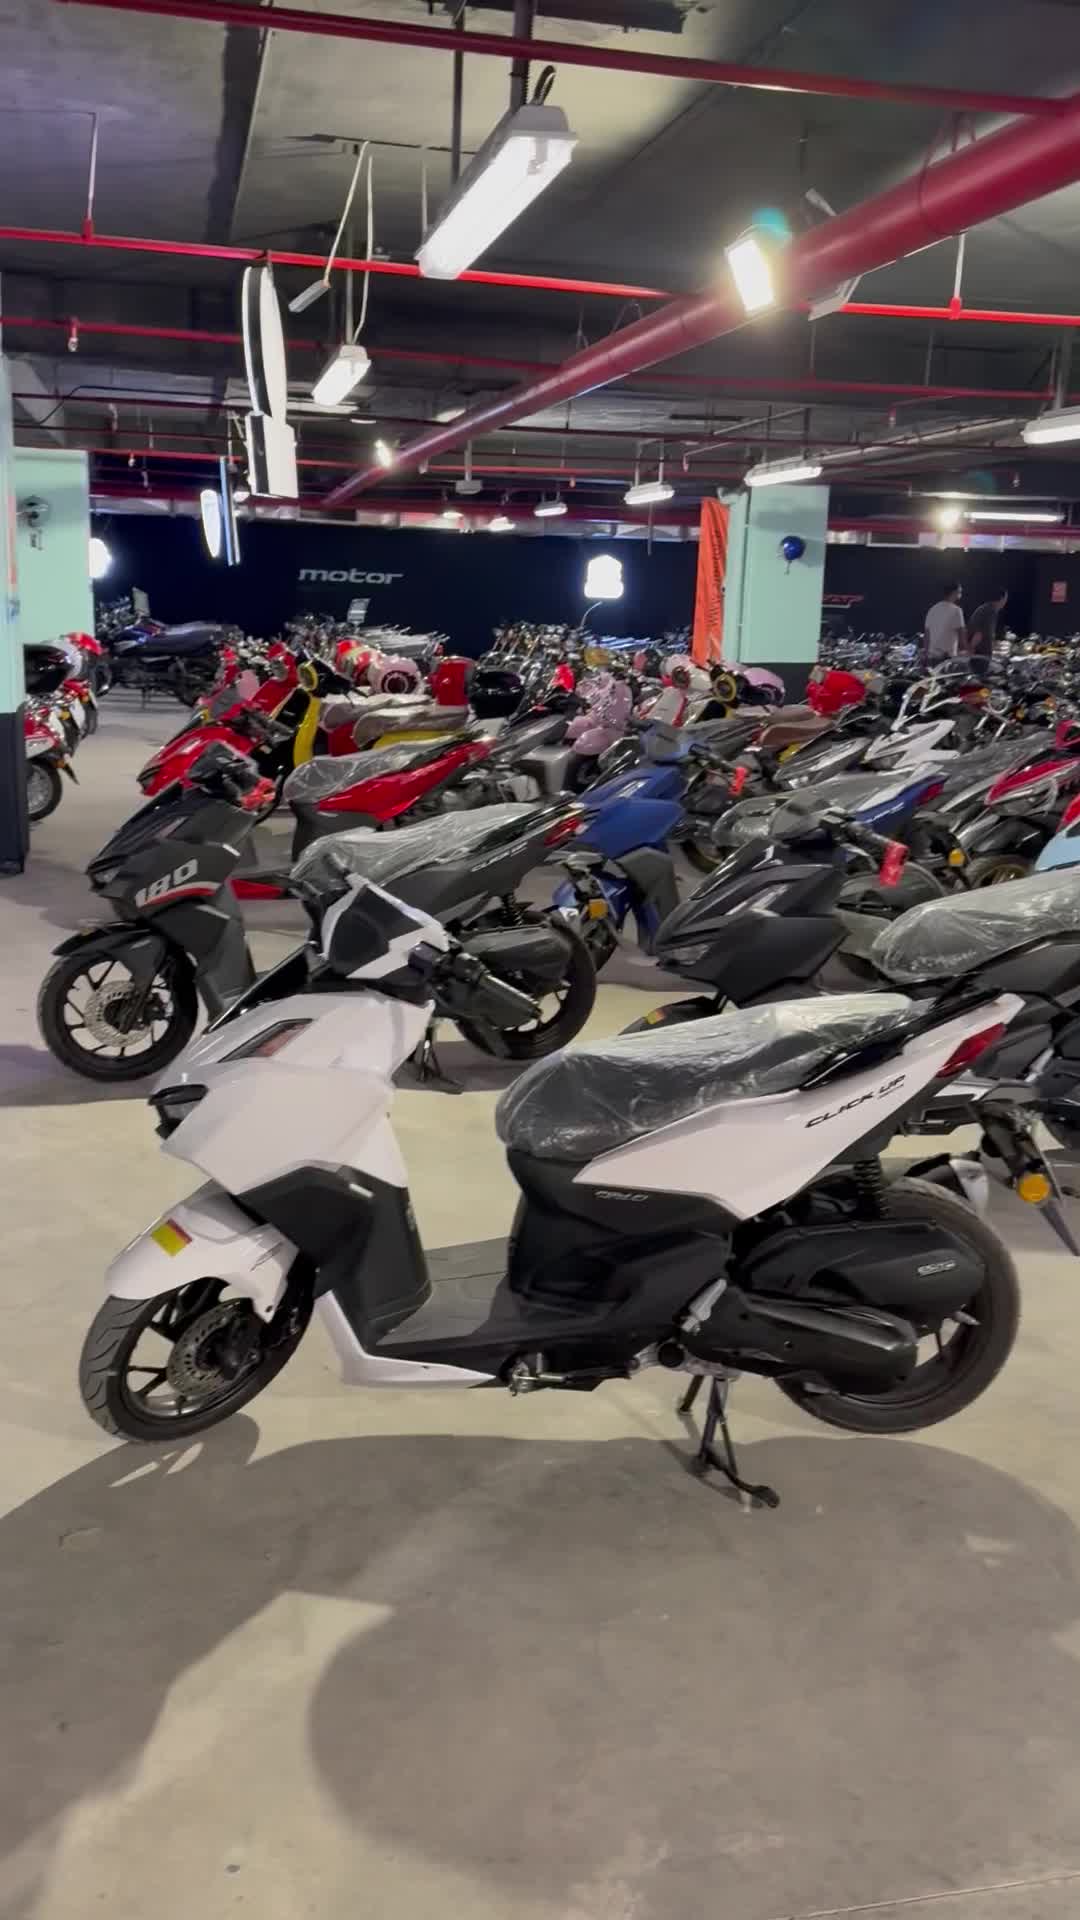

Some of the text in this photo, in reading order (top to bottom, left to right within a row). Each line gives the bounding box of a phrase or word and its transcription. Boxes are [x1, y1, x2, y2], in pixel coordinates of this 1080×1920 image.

[299, 568, 404, 584] motor
[135, 858, 199, 908] 180
[804, 1074, 906, 1128] CLICK UP
